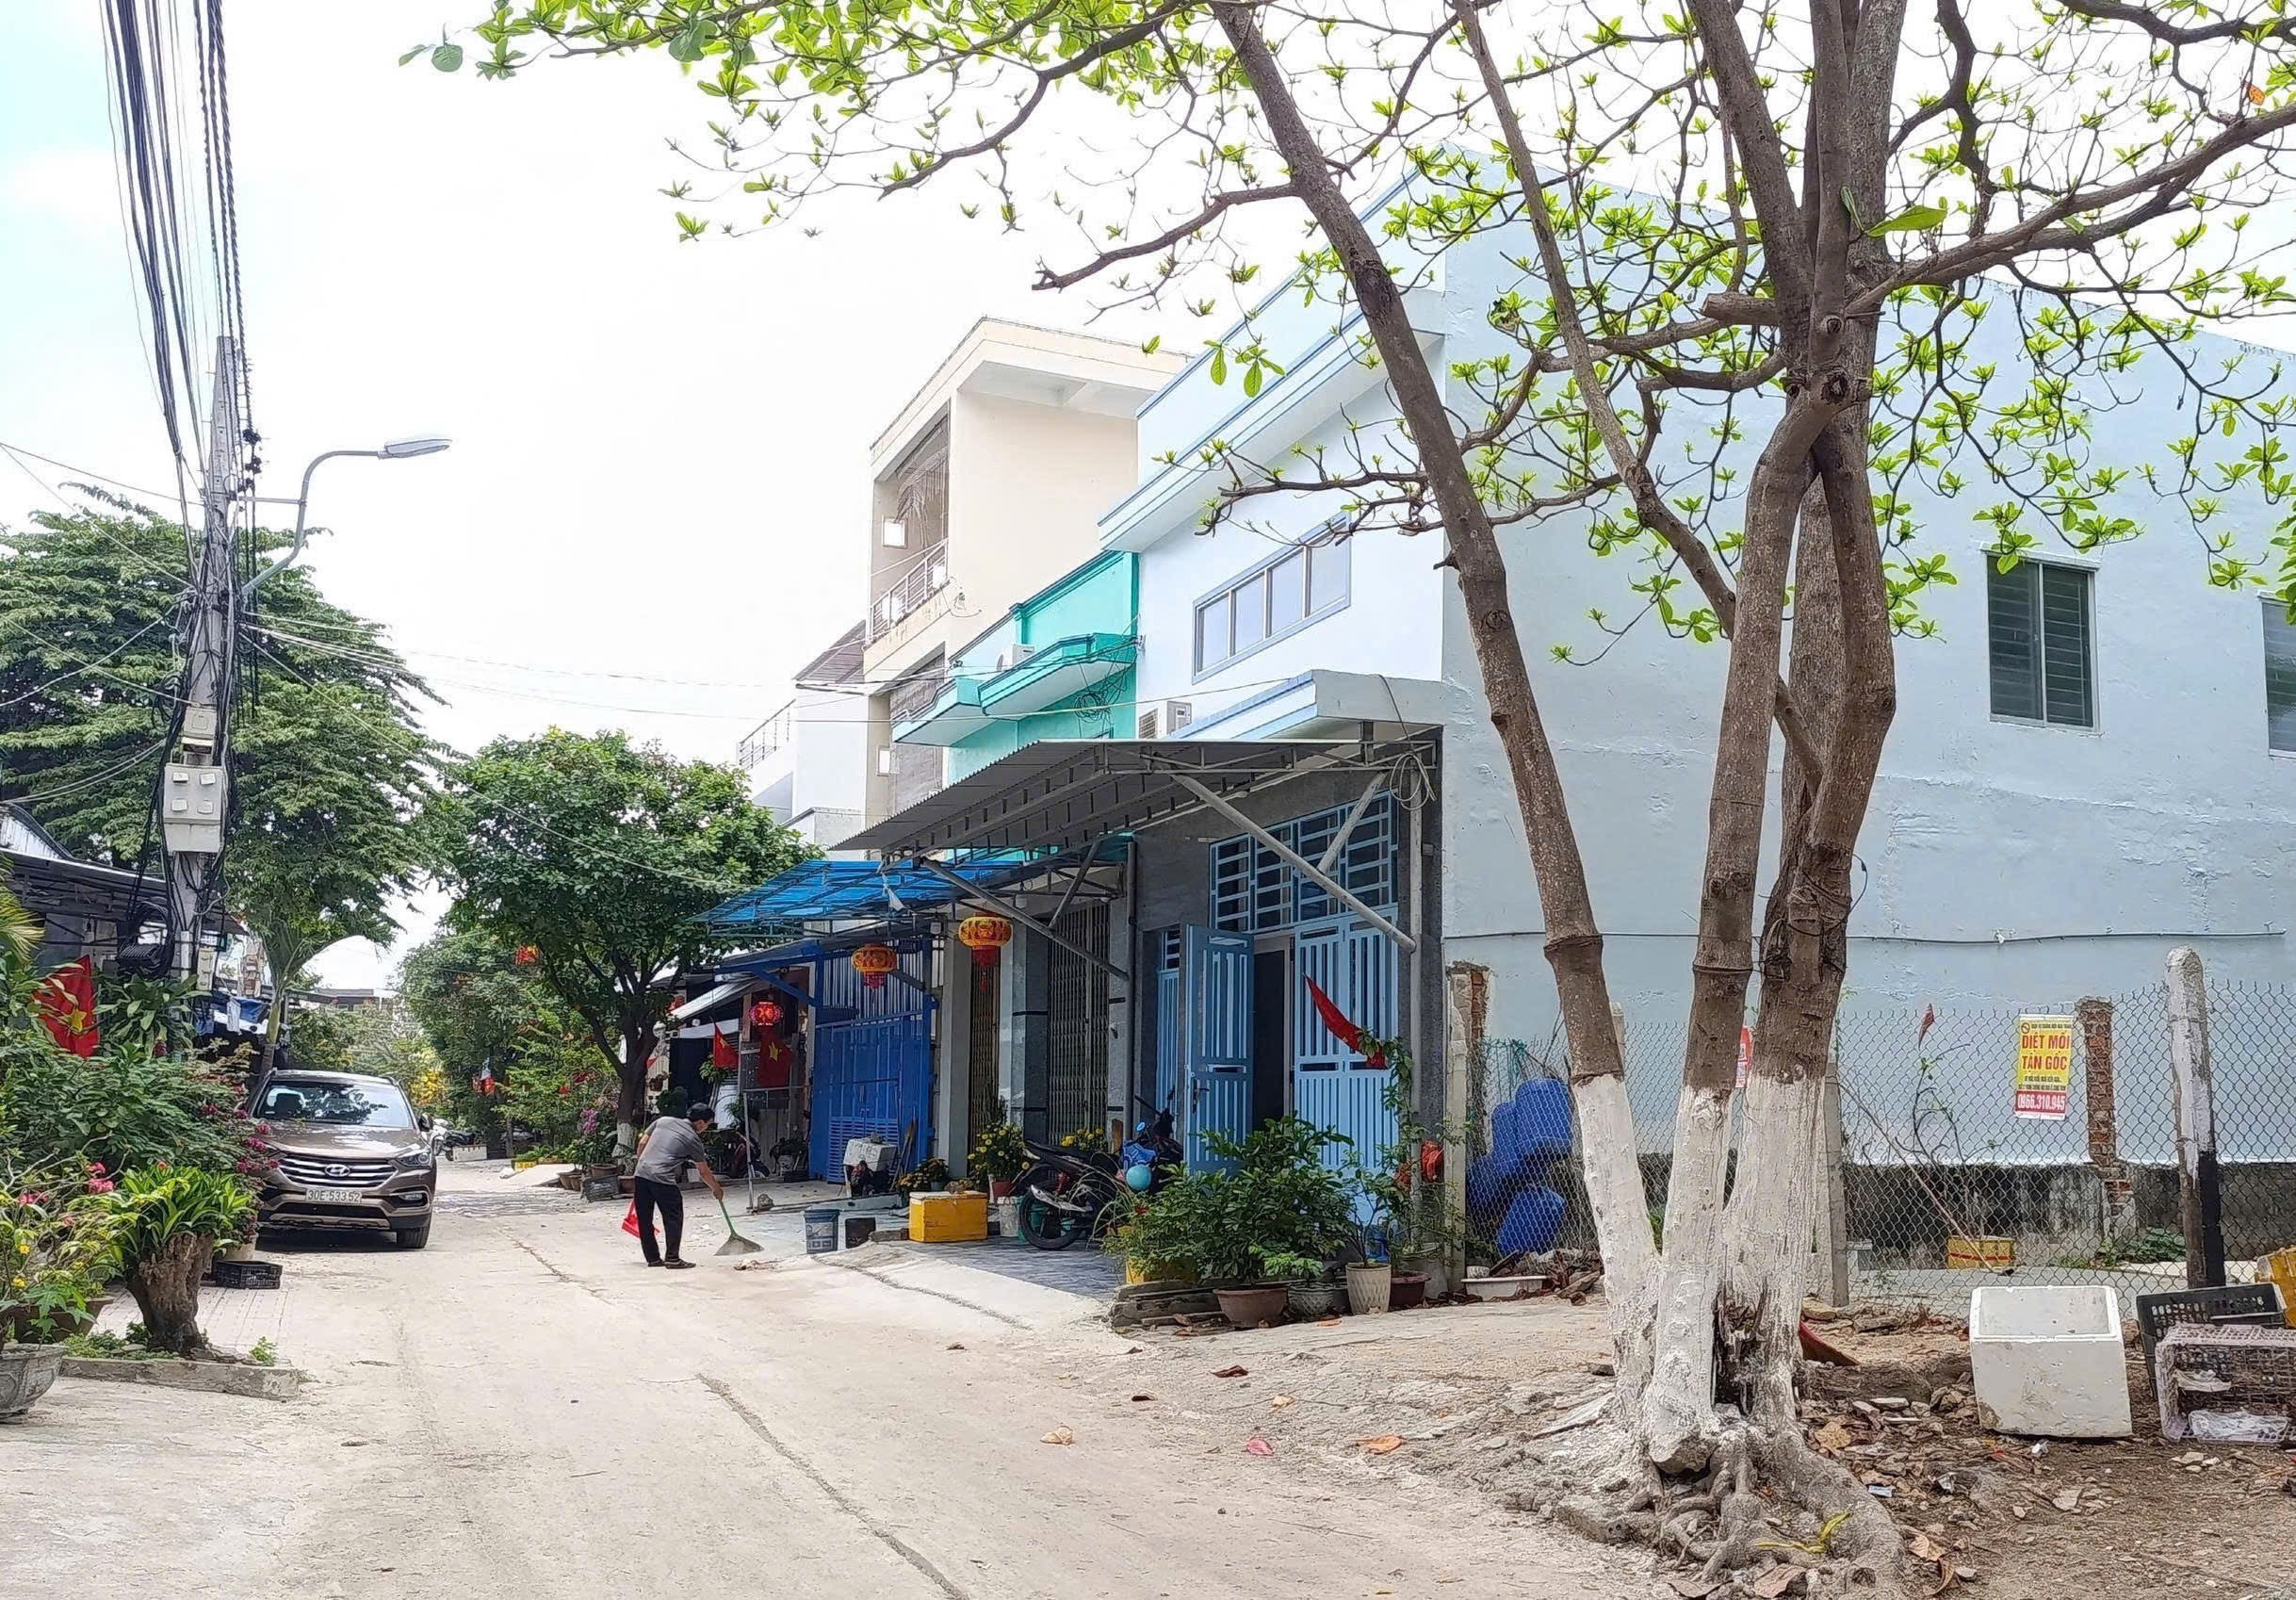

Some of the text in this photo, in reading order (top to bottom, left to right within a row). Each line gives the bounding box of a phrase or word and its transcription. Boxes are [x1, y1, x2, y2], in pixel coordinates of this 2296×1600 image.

[2022, 1032, 2045, 1052] DIỆT
[2022, 1051, 2067, 1072] TẬN GỐC
